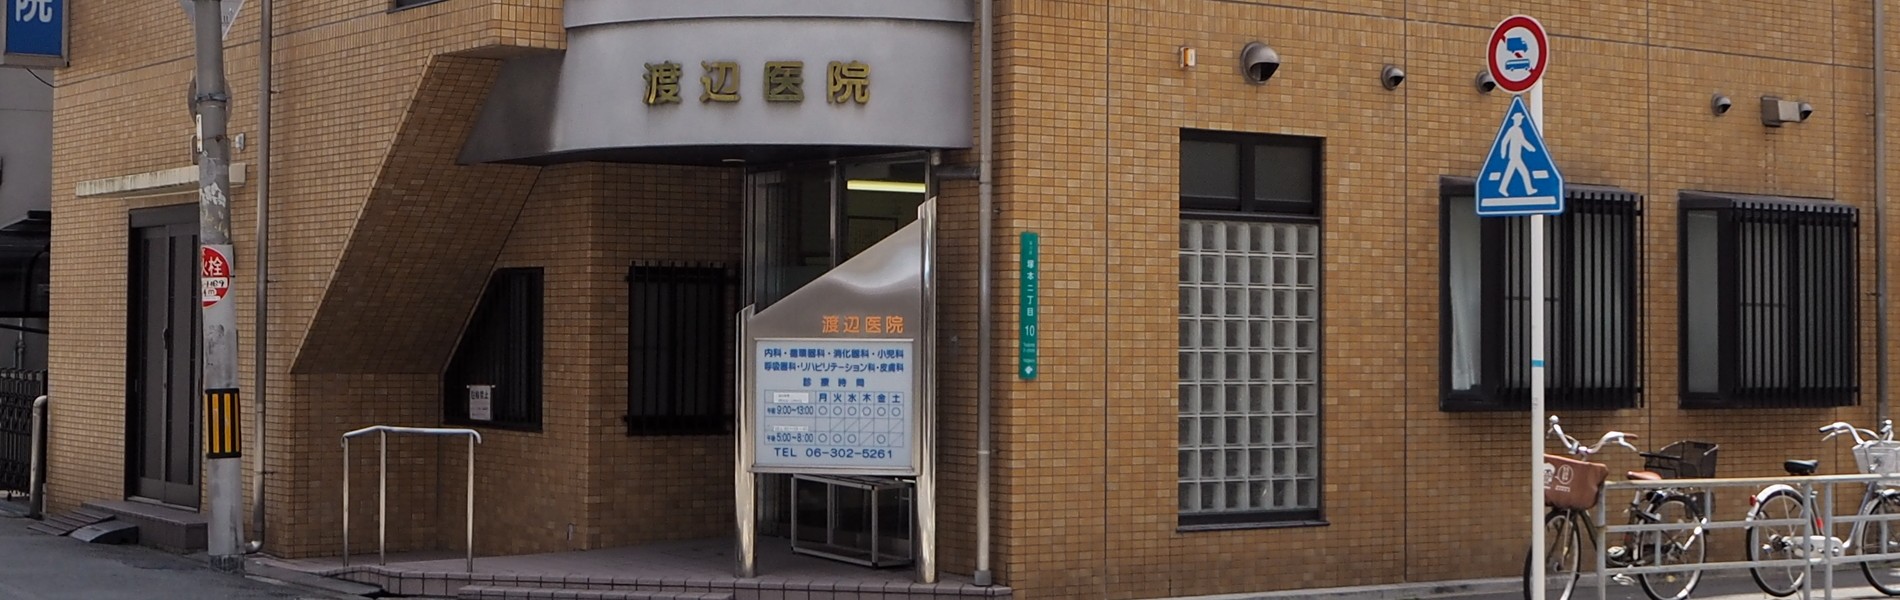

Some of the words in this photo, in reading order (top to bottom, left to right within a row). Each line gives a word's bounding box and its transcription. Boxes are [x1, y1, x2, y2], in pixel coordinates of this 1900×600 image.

[642, 60, 871, 105] 渡辺医院
[821, 315, 905, 334] 渡辺医院
[1025, 324, 1035, 337] 10
[818, 393, 828, 403] 月
[833, 393, 842, 403] 火
[848, 393, 857, 403] 水
[862, 393, 872, 403] 木
[877, 393, 886, 403] 金
[892, 393, 901, 403] 土
[774, 448, 797, 457] TEL
[806, 447, 893, 459] 06-302-5261
